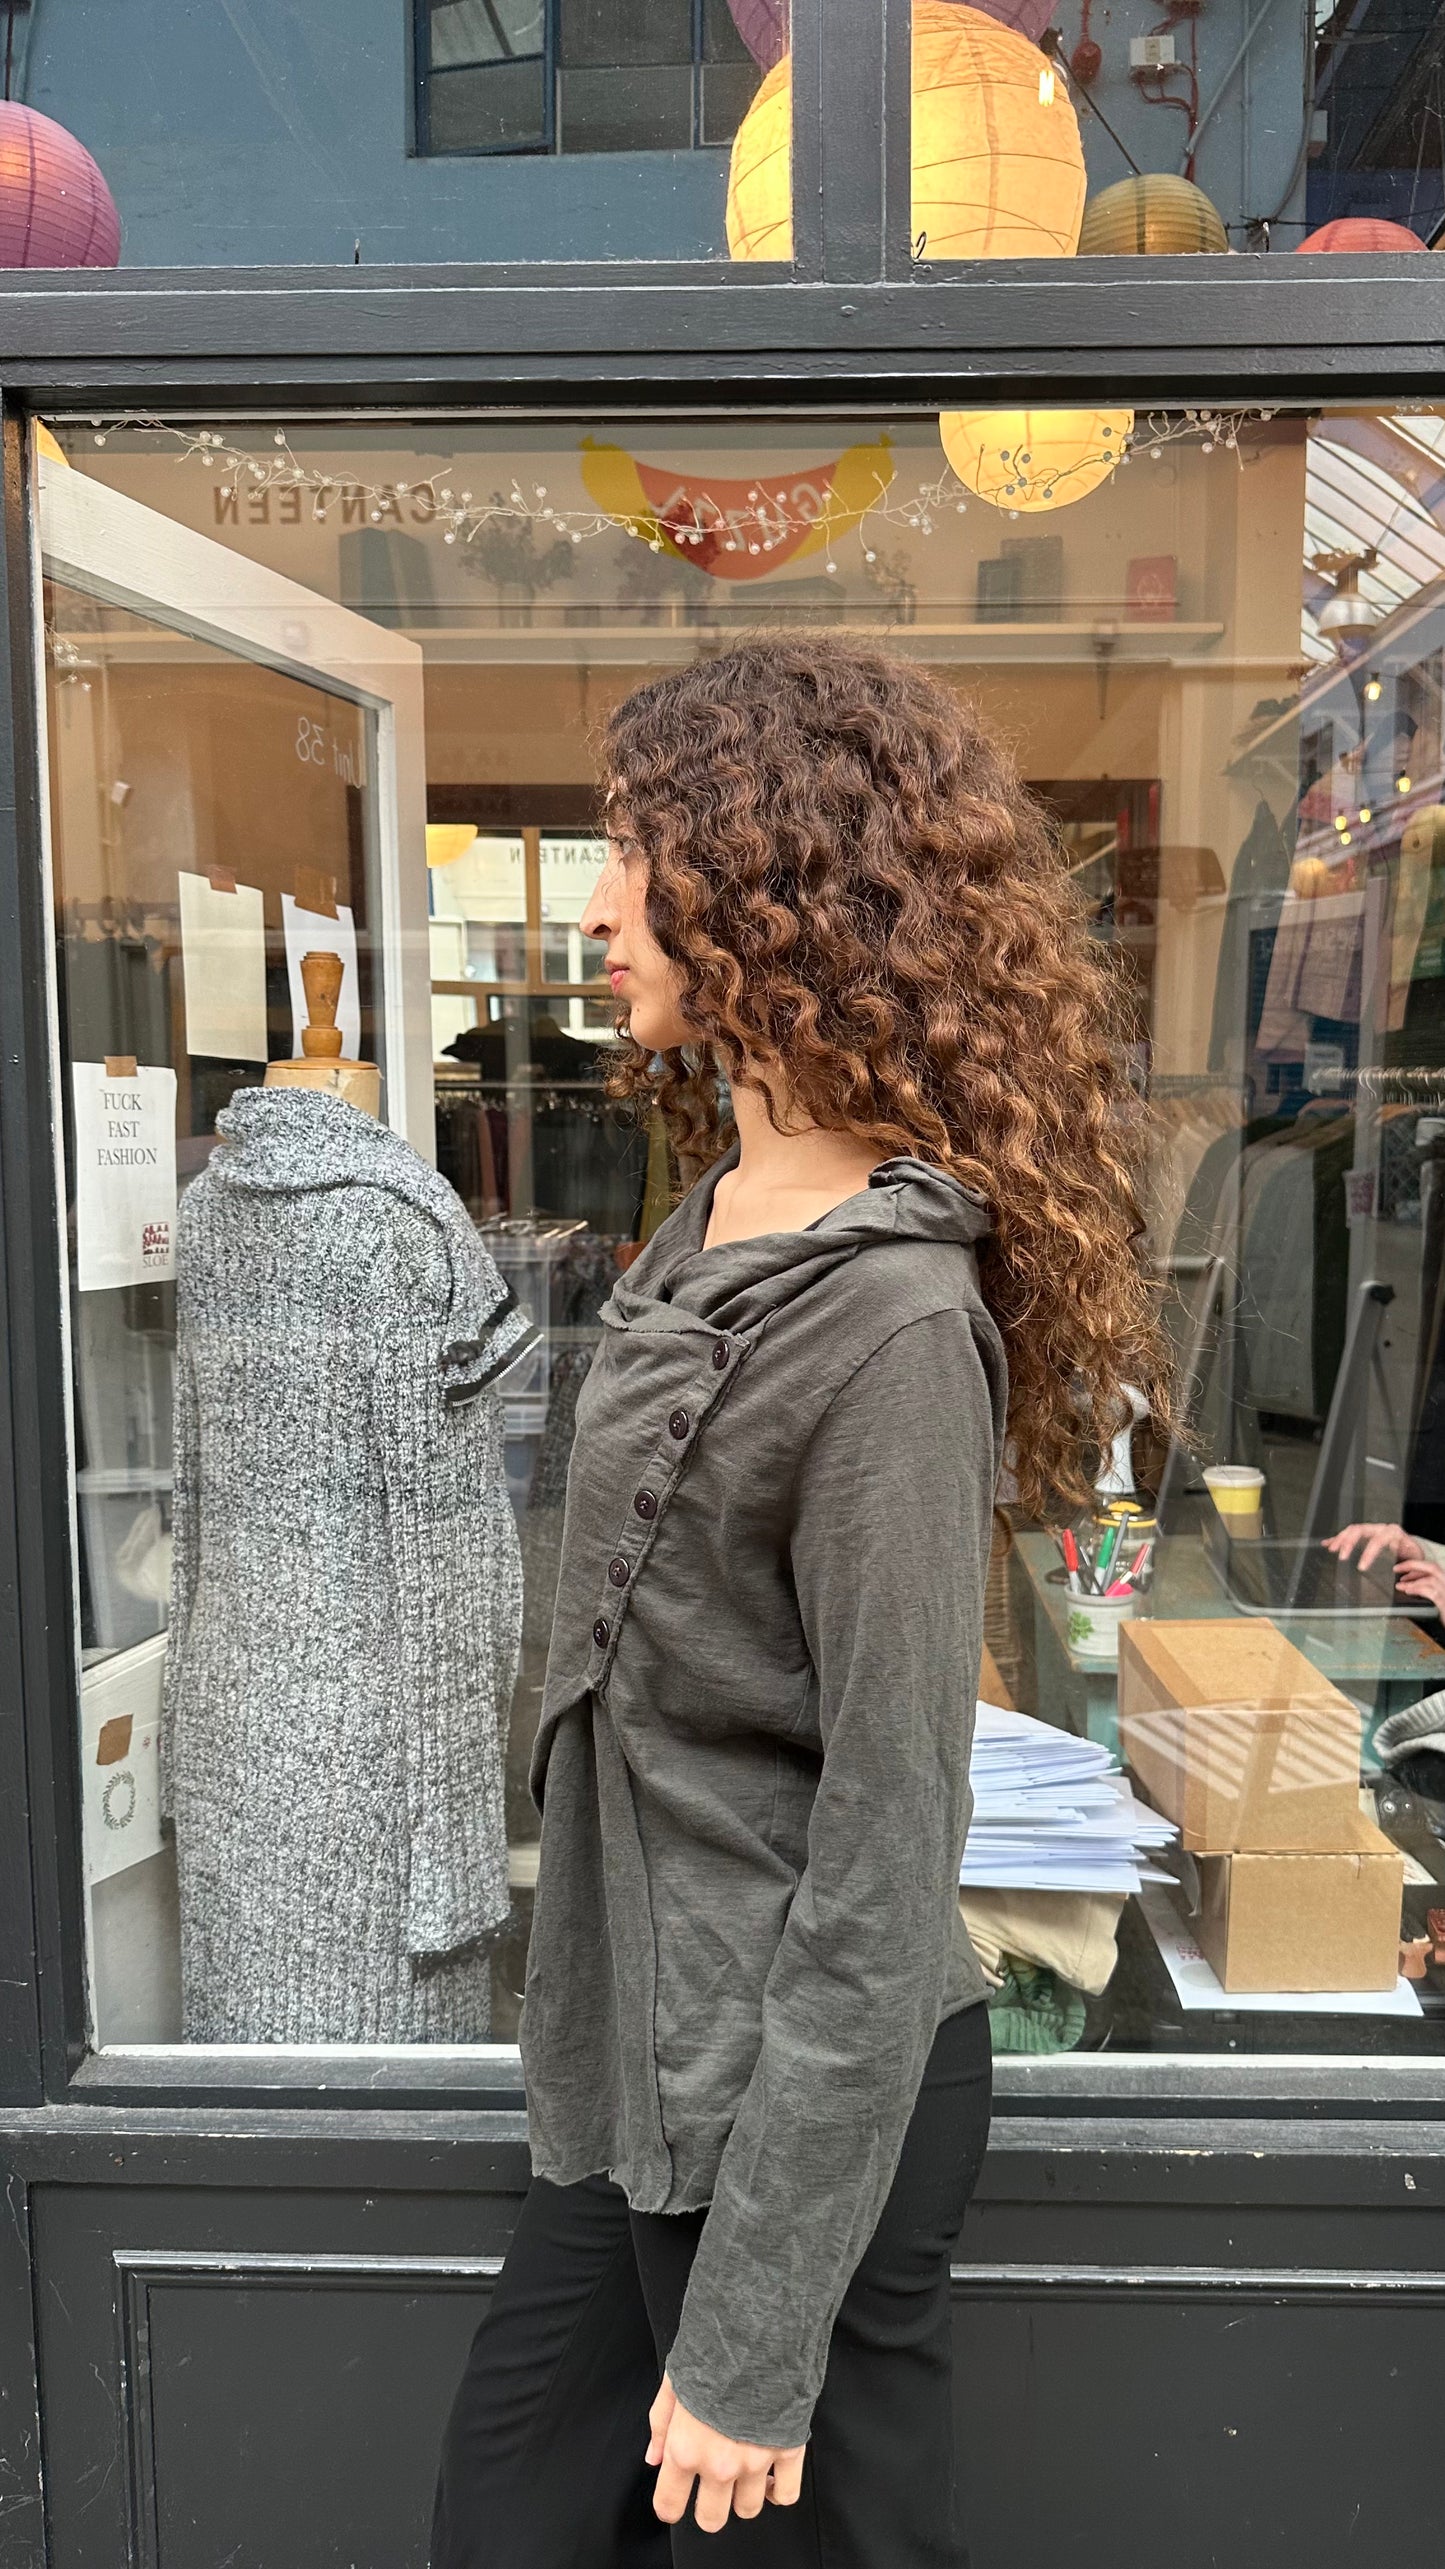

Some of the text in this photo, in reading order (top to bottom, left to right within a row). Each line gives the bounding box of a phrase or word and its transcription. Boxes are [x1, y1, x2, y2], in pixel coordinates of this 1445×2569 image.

[104, 1092, 143, 1111] FUCK
[108, 1121, 140, 1138] FAST
[97, 1147, 157, 1166] FASHION
[142, 1255, 169, 1269] SLOE
